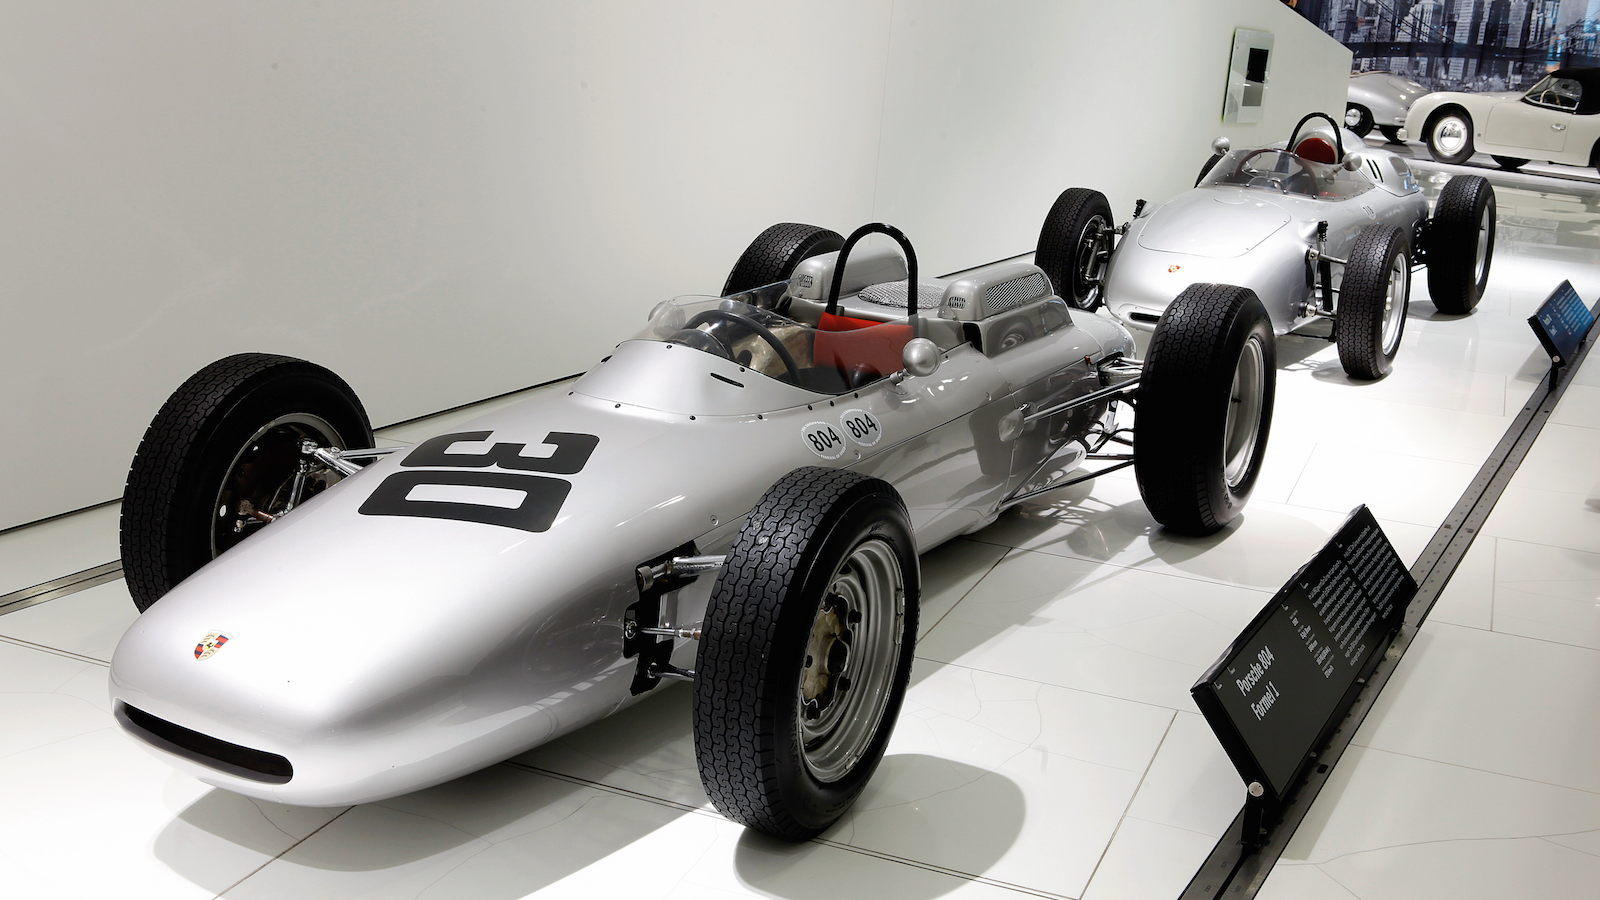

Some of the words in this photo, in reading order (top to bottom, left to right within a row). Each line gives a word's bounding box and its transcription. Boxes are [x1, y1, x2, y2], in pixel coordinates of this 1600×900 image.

[808, 427, 841, 451] 804
[846, 414, 877, 438] 804
[357, 430, 600, 533] 30
[1235, 662, 1265, 697] Porsche
[1257, 645, 1275, 670] 804
[1250, 685, 1277, 721] Formel
[1269, 680, 1280, 697] 1
